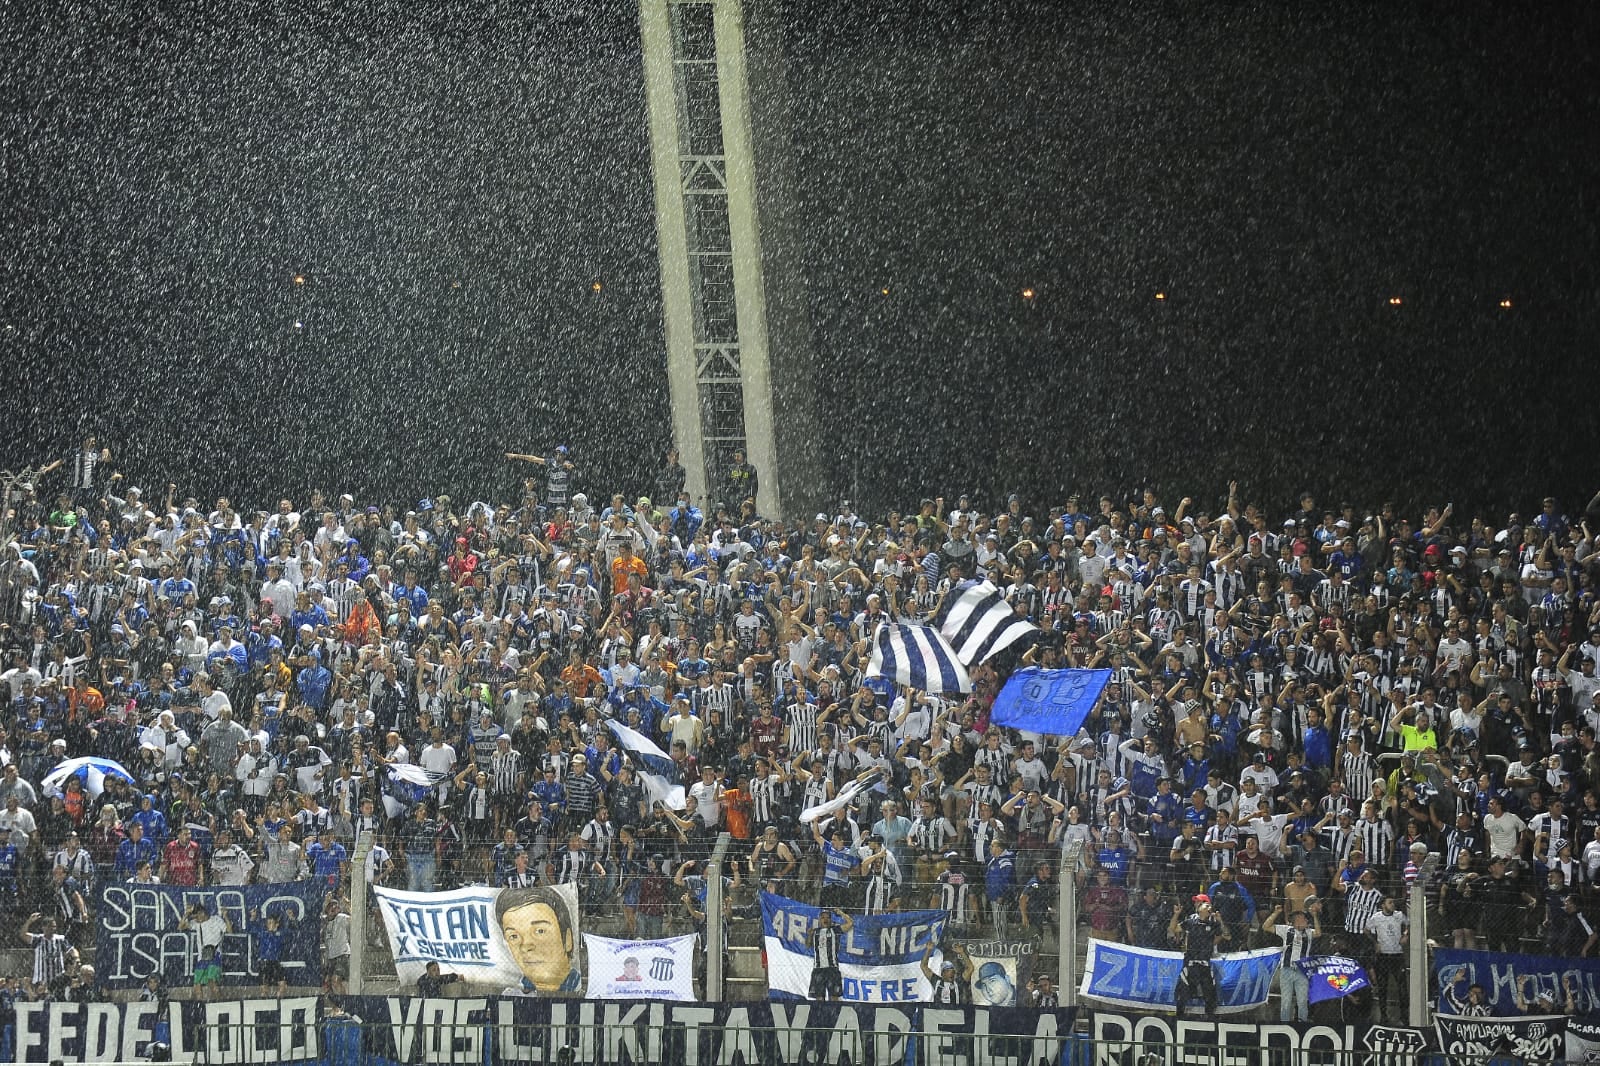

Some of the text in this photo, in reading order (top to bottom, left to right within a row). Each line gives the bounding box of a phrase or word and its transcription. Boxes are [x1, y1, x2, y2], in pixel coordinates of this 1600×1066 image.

[758, 735, 776, 743] BBVA
[102, 887, 247, 931] SANTA
[388, 901, 491, 940] TATAN
[396, 936, 491, 960] X SIEMPRE
[772, 908, 865, 955] ARL
[14, 996, 319, 1064] FEDE LOCO
[387, 998, 487, 1064] VOS
[499, 1001, 759, 1066] LUKITA
